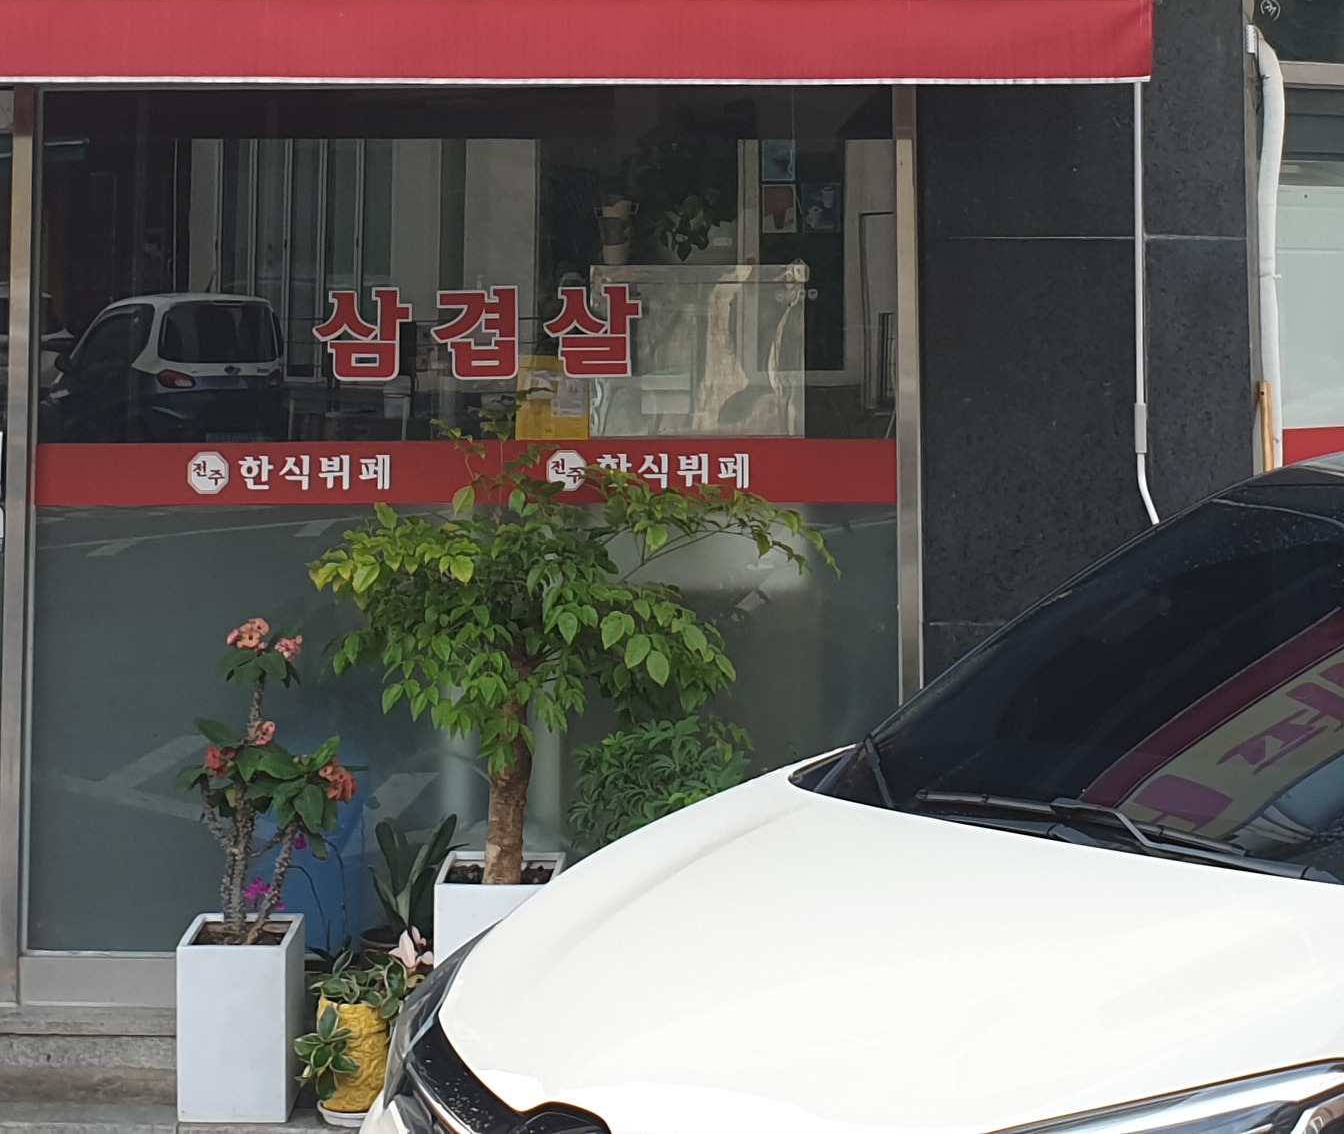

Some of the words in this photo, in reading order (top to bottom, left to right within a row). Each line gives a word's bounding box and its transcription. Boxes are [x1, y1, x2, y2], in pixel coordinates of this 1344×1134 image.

[313, 282, 643, 380] 삼겹살
[192, 460, 226, 486] 전주
[238, 454, 391, 490] 한식뷔페
